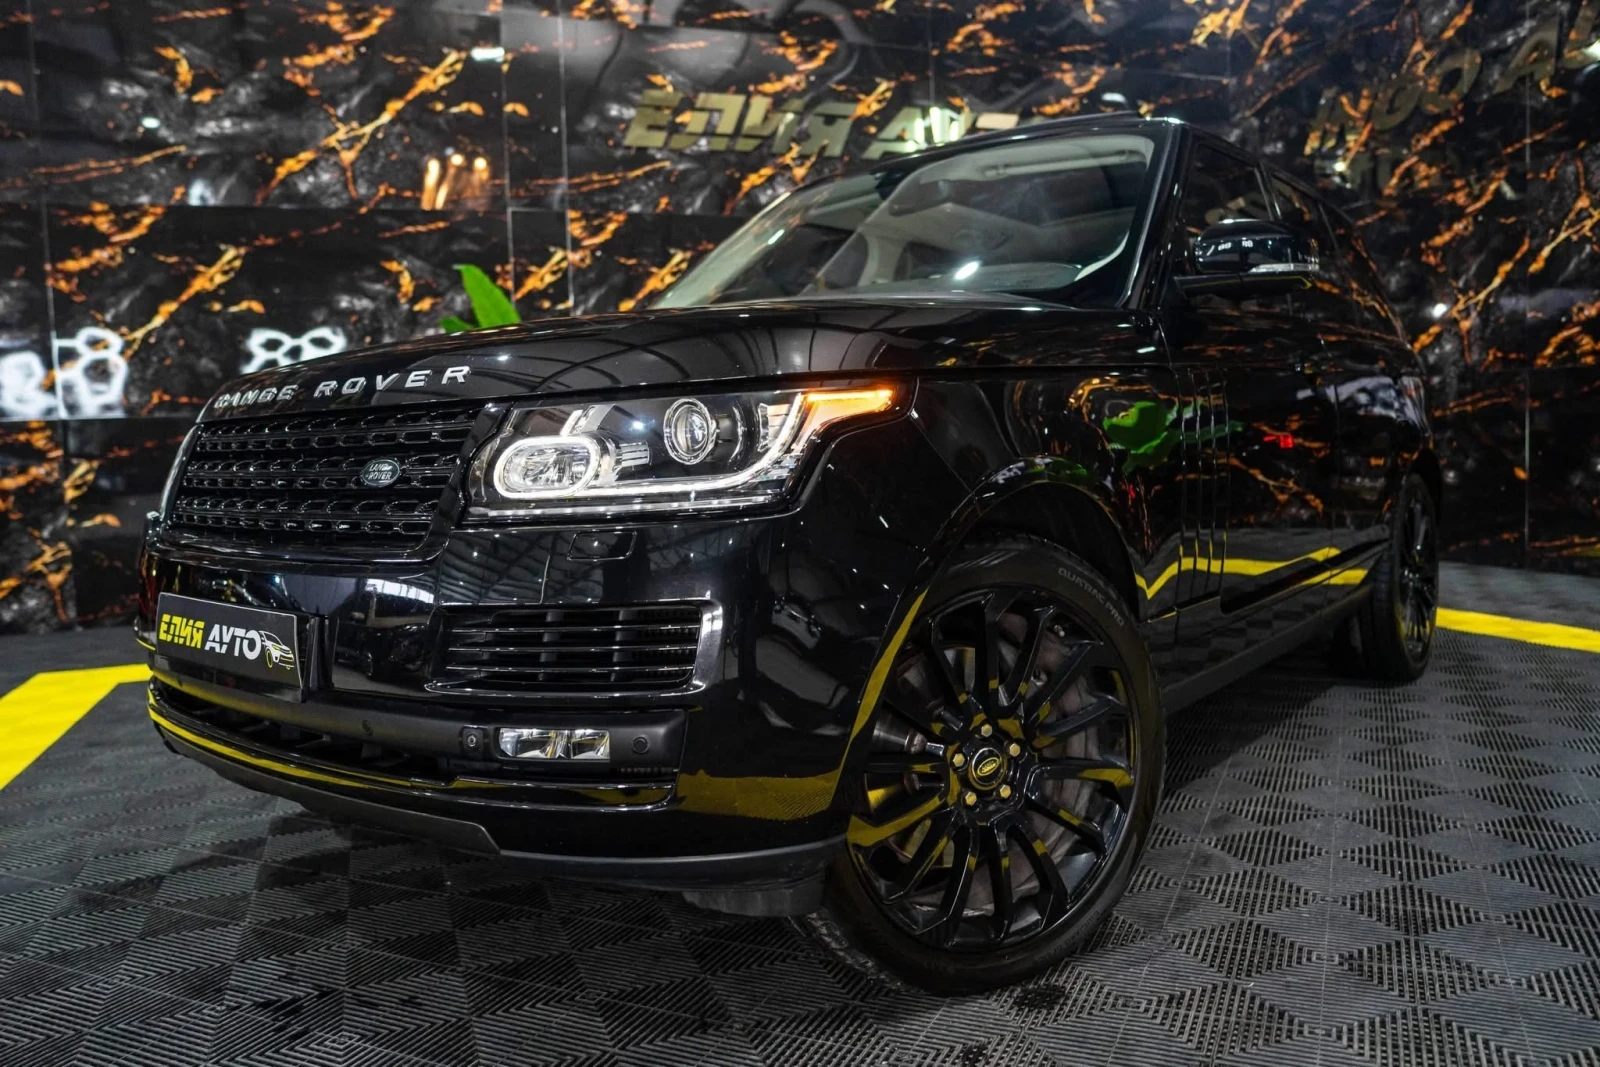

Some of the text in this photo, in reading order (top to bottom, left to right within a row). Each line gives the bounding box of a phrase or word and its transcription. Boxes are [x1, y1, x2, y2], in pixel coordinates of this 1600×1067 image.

[213, 365, 472, 409] RANGE ROVER
[367, 471, 393, 480] ROVER
[1057, 566, 1126, 628] QUATRAC PRO
